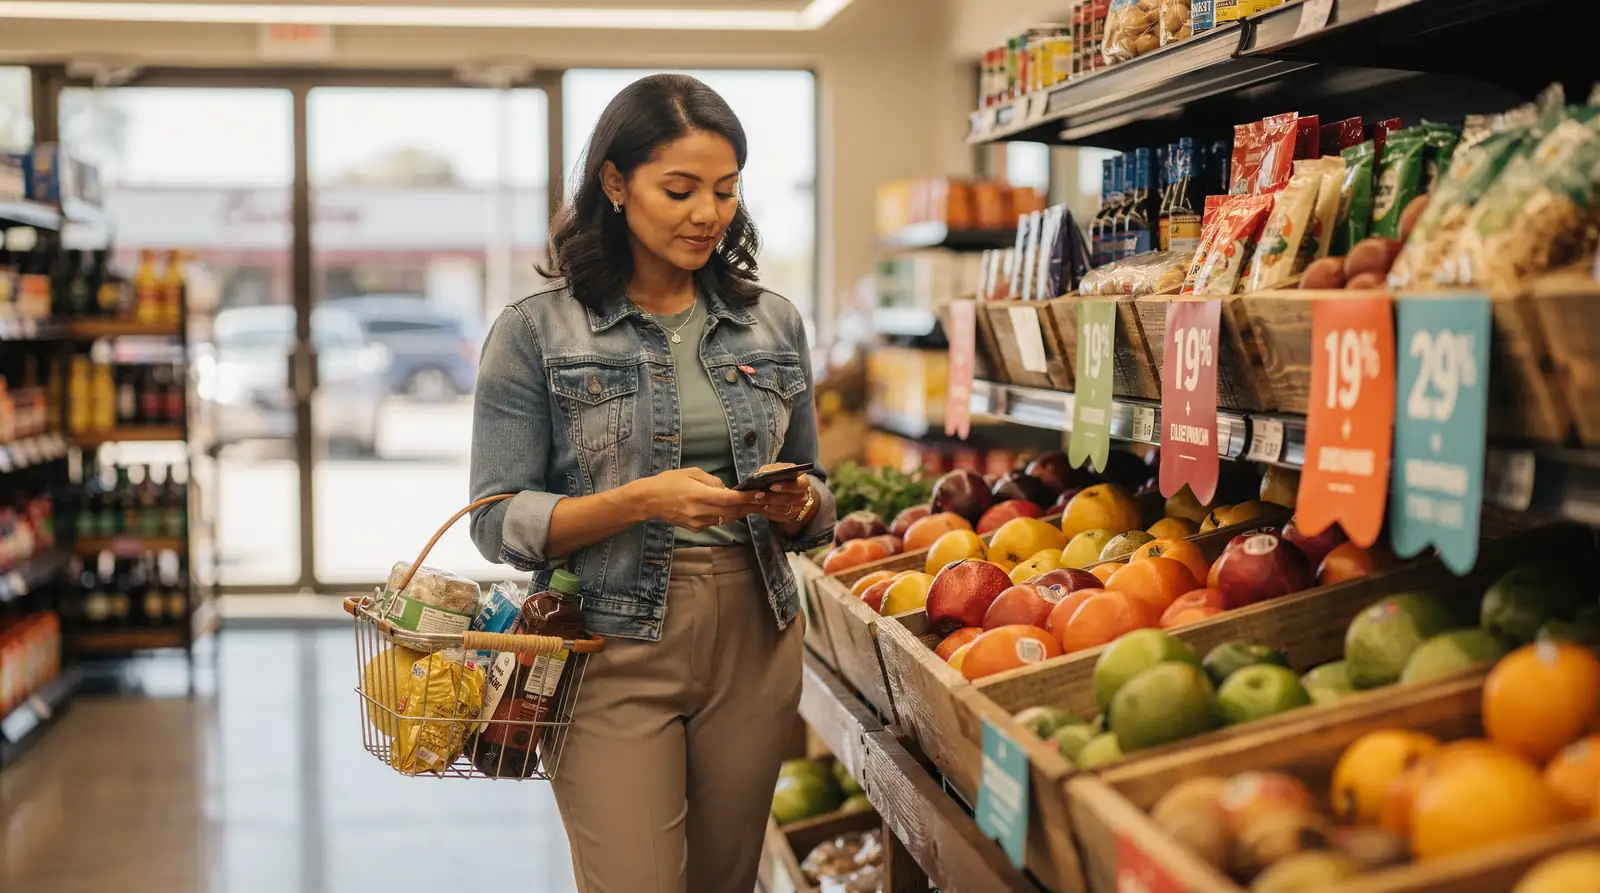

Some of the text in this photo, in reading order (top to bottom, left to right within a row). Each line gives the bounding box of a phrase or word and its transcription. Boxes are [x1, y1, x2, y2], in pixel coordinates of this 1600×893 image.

[1083, 322, 1110, 379] 19%
[1174, 326, 1212, 392] 19%
[1324, 327, 1381, 410] 19%
[1407, 328, 1477, 422] 29%
